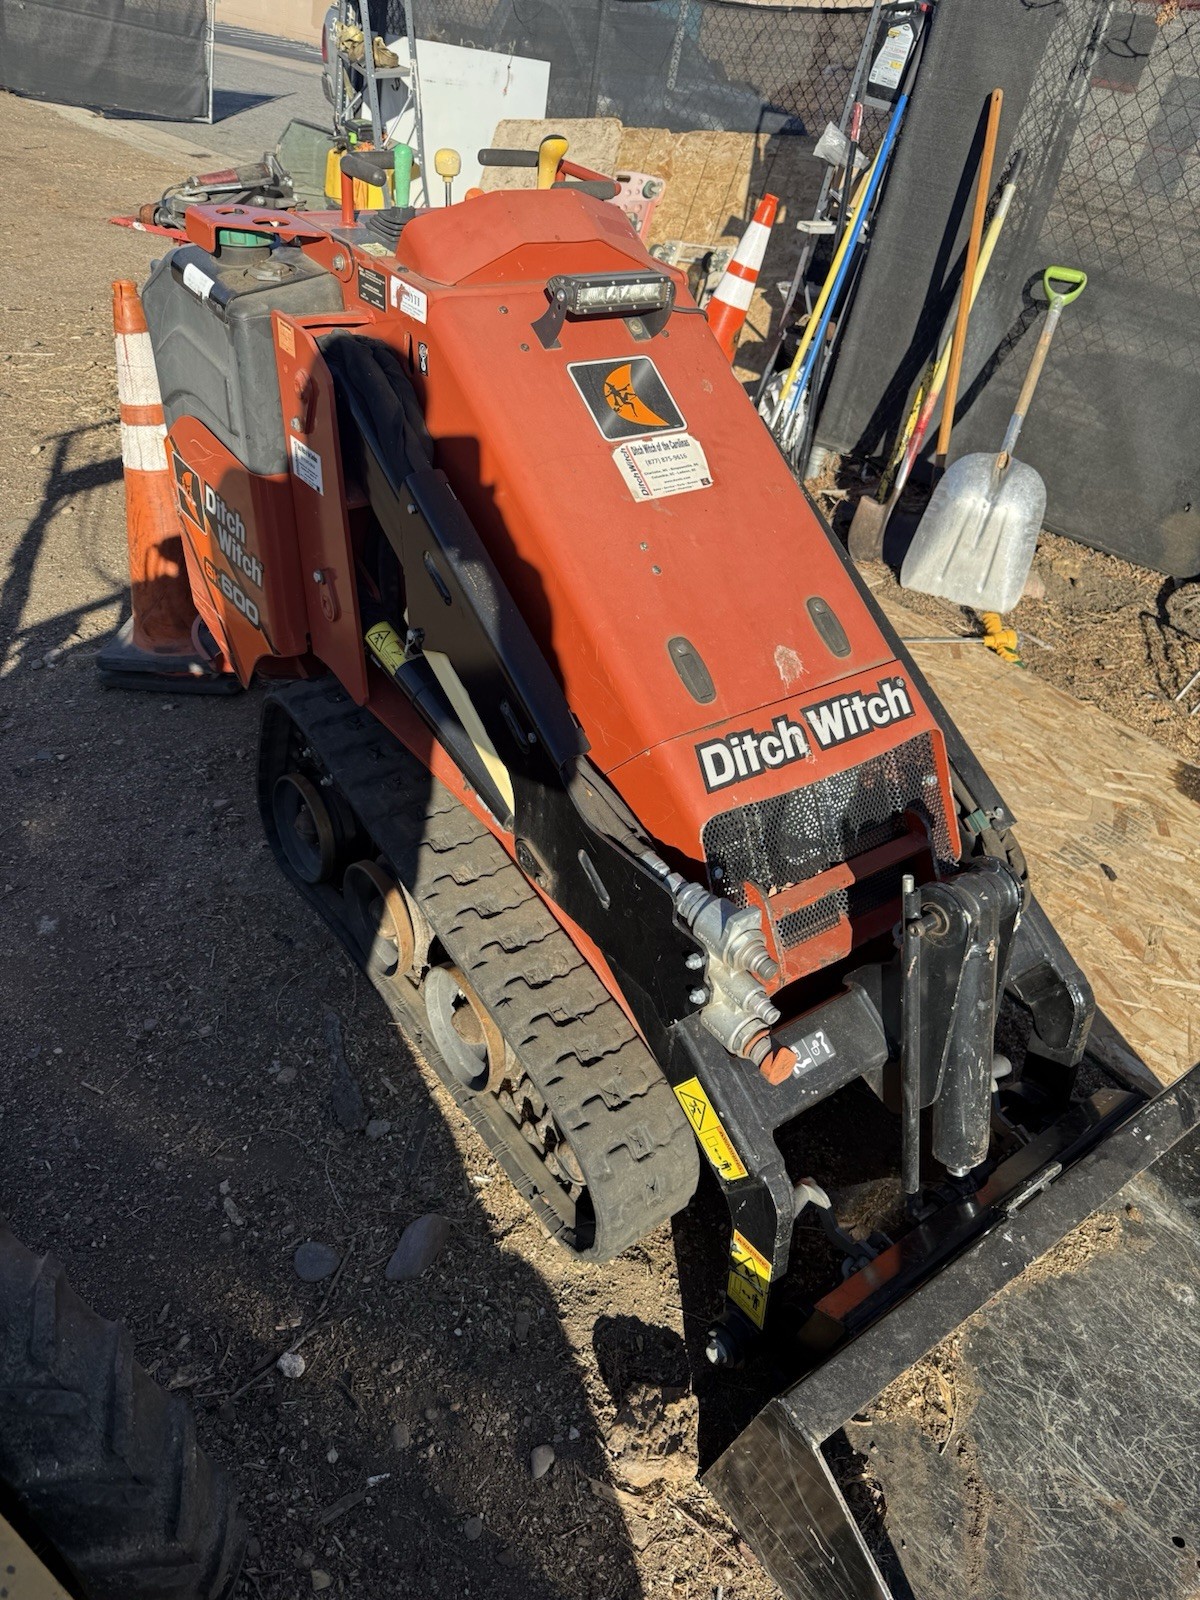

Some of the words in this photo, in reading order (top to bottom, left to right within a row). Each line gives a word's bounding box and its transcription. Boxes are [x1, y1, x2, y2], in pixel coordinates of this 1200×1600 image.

[205, 484, 246, 544] Ditch
[218, 525, 263, 588] Witch
[699, 719, 809, 789] Ditch
[805, 682, 912, 747] Witch
